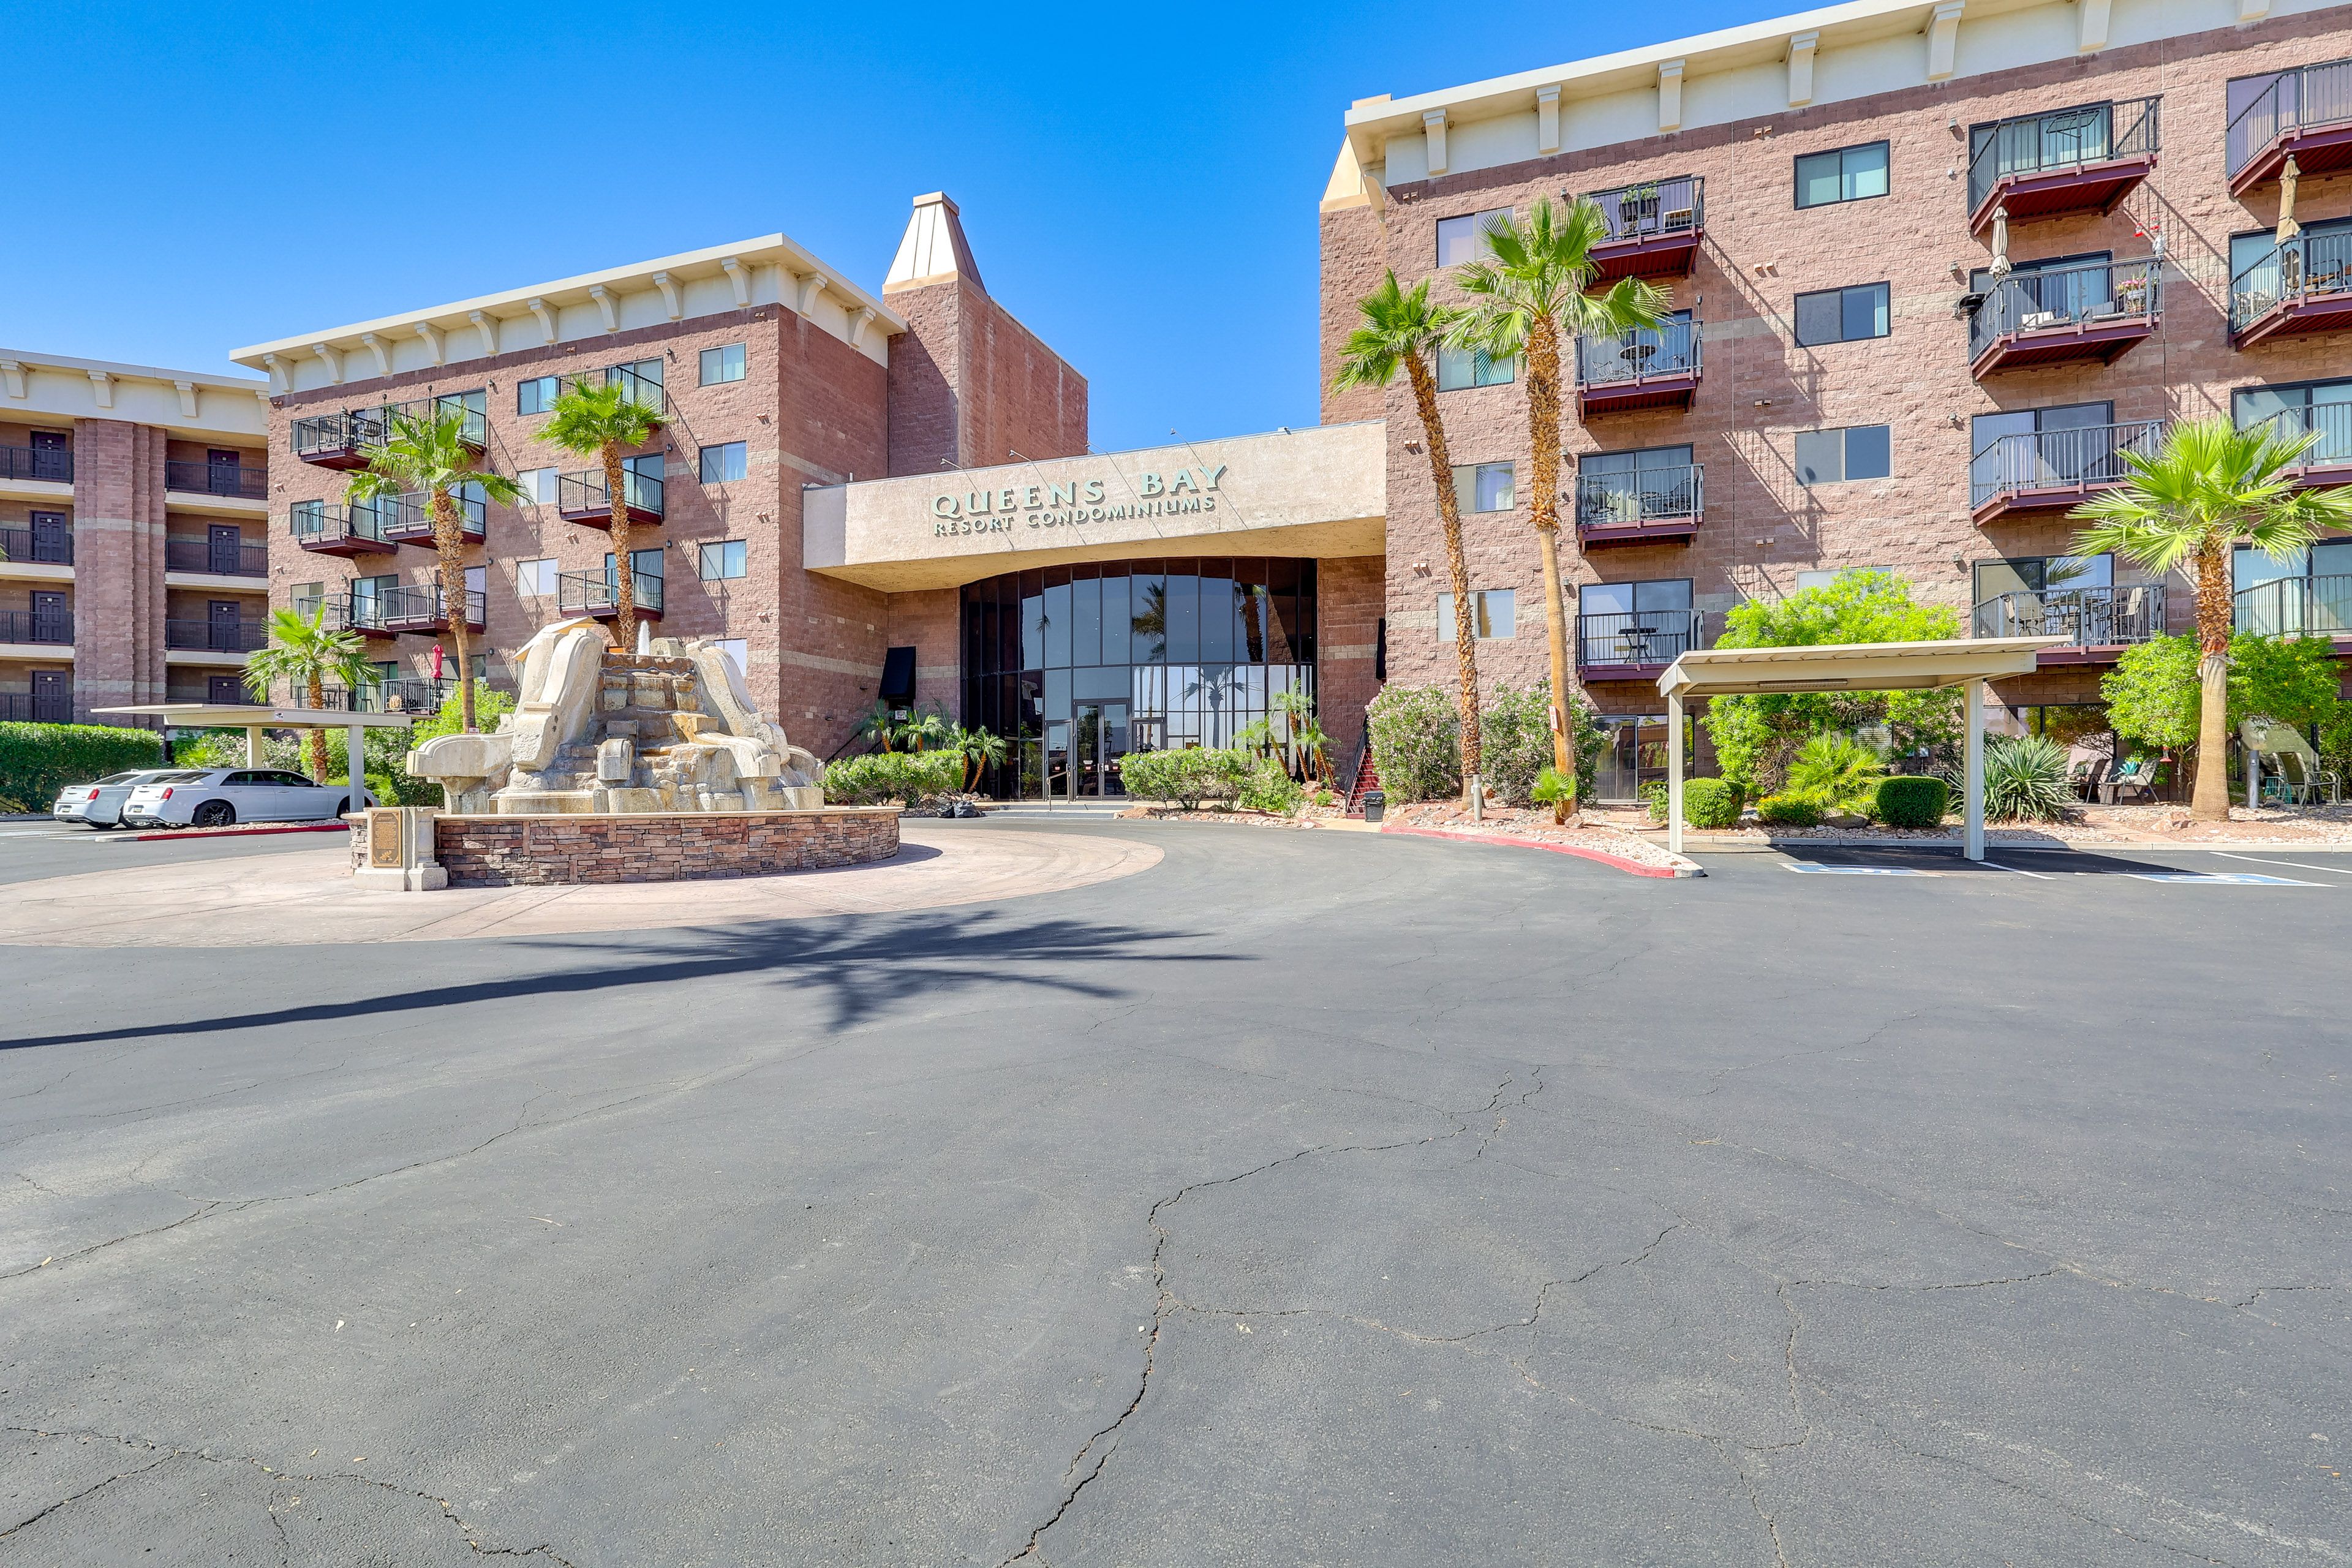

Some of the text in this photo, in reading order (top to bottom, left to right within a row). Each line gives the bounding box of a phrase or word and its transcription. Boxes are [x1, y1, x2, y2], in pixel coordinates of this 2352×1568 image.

[931, 464, 1227, 519] QUEENS BAY
[934, 496, 1215, 536] RESORT CONDOMINIUMS
